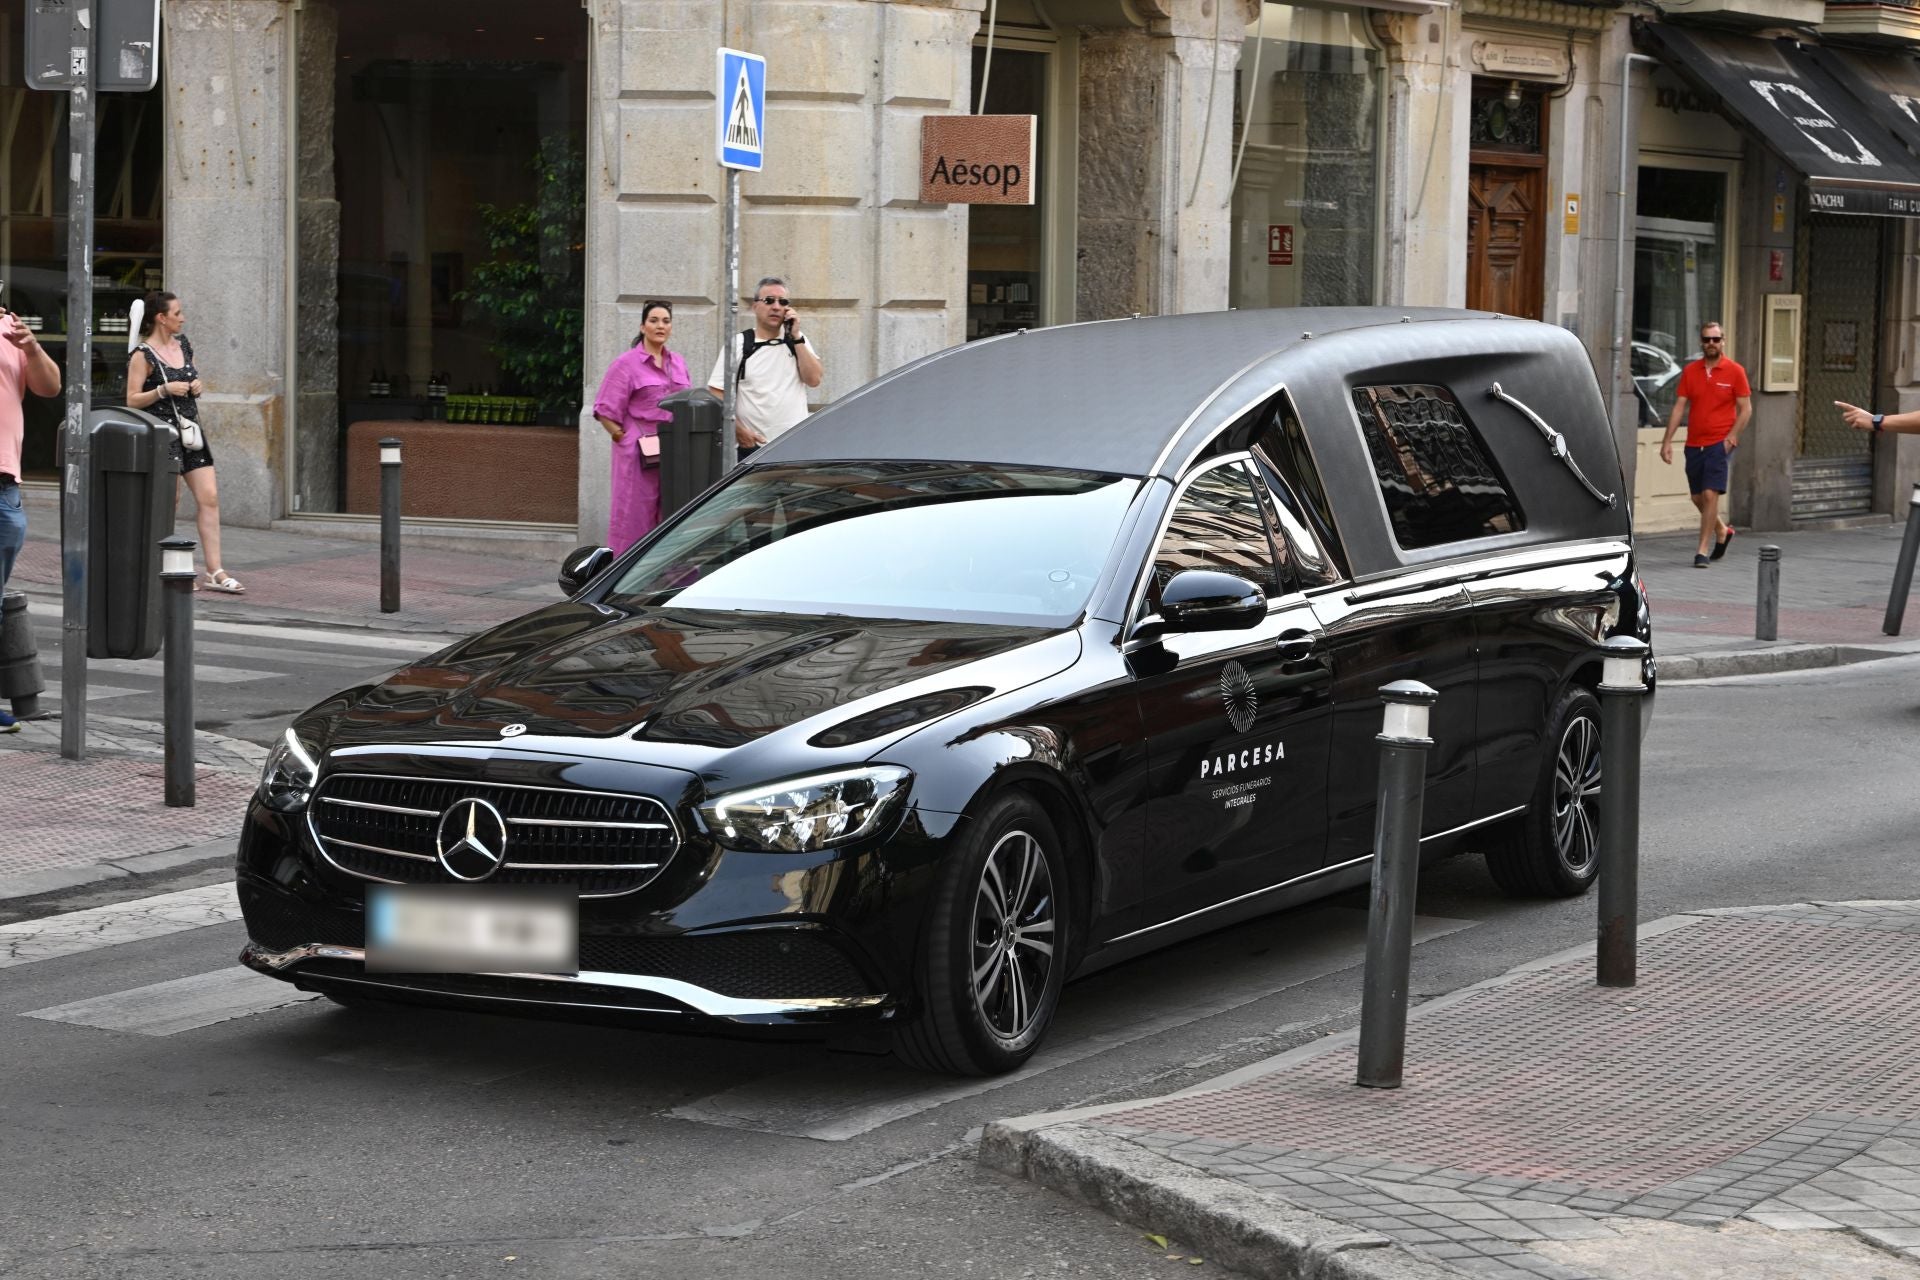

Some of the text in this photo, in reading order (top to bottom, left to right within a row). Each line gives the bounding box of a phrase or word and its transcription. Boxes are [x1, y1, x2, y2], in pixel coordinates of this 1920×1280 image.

[930, 155, 1021, 196] Aēsop
[1888, 198, 1907, 212] THAI
[1200, 741, 1285, 779] PARCESA
[1212, 776, 1272, 800] SERVICIOS FUNERARIOS
[1224, 793, 1257, 810] INTEGRALES
